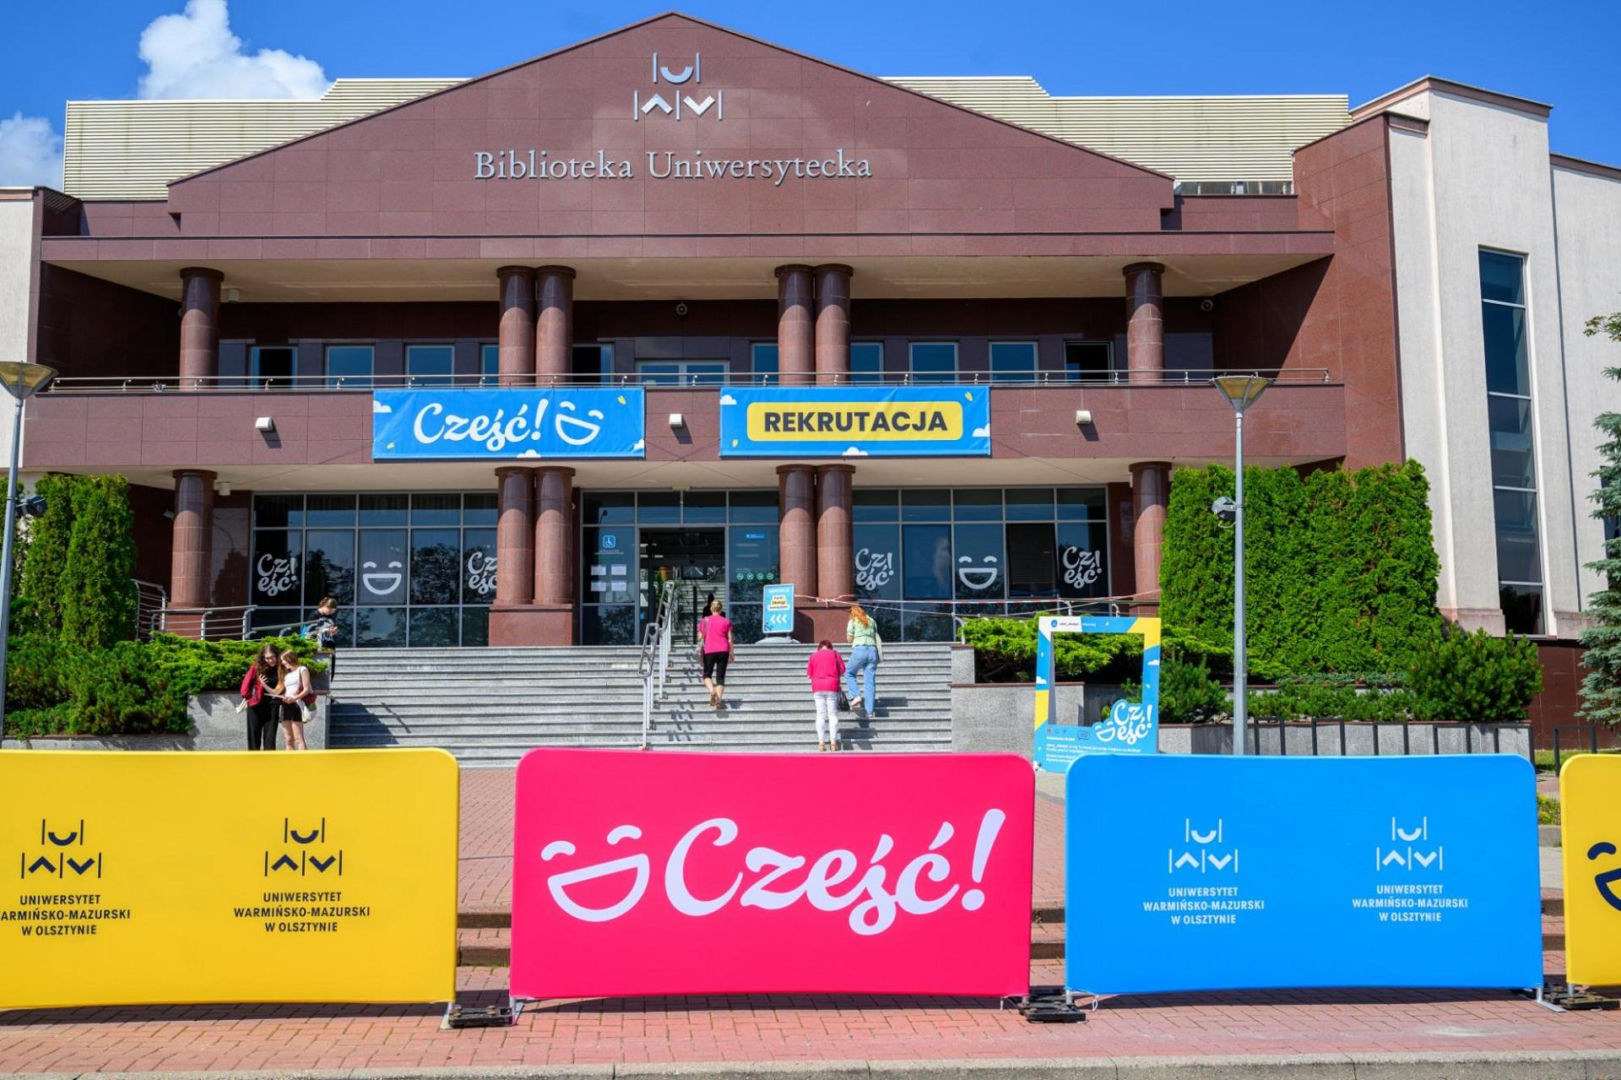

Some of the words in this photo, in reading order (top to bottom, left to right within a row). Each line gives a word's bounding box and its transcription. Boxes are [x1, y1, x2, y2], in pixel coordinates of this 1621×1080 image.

[474, 149, 634, 180] Biblioteka
[646, 148, 873, 187] Uniwersytecka
[413, 398, 549, 452] Cześć!
[764, 411, 948, 433] REKRUTACJA
[664, 808, 1006, 936] Cześć!
[1168, 887, 1238, 897] UNIWERSYTET
[1376, 885, 1443, 894] UNIWERSYTET
[20, 895, 101, 905] UNIWERSYTET
[263, 892, 342, 902] UNIWERSYTET
[1352, 896, 1469, 908] WARMIŃSKO-MAZURSKI
[234, 905, 370, 917] WARMIŃSKO-MAZURSKI
[1143, 900, 1265, 912] WARMIŃSKO-MAZURSKI
[0, 908, 131, 921] ARMIŃSKO-MAZURSKI
[1171, 915, 1181, 925] W
[1183, 915, 1237, 924] OLSZTYNIE
[1379, 912, 1388, 922] W
[1391, 912, 1442, 922] OLSZTYNIE
[22, 926, 32, 936] W
[35, 925, 97, 936] OLSZTYNIE
[265, 922, 275, 932] W
[278, 922, 338, 932] OLSZTYNIE
